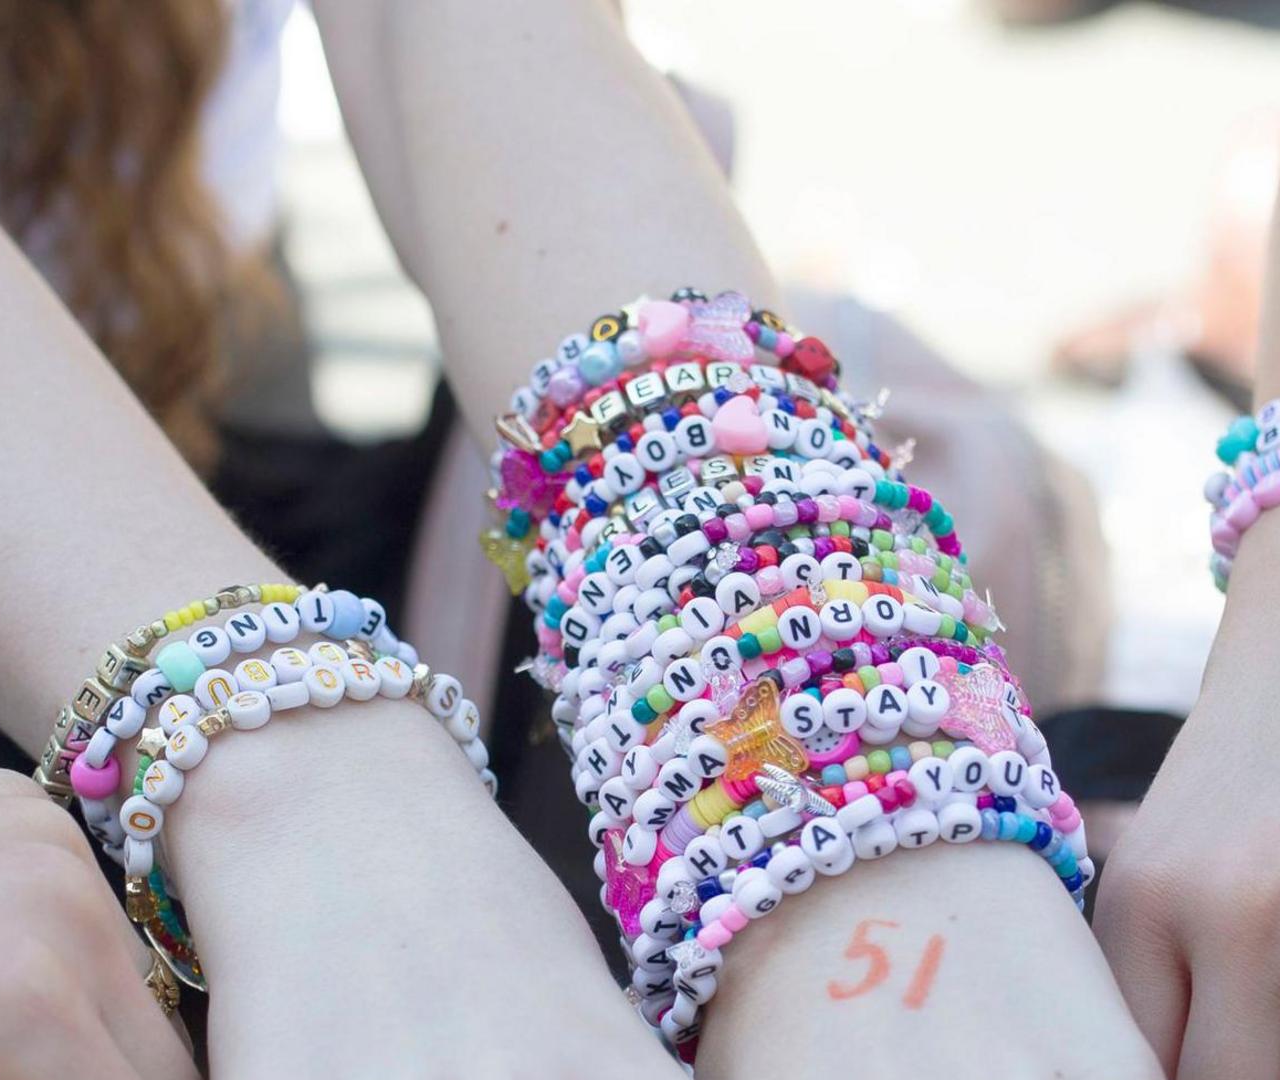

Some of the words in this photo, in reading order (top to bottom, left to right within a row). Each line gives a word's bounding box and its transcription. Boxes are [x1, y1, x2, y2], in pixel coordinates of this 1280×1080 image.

[614, 423, 706, 487] BOY
[792, 685, 937, 734] STAY
[926, 760, 1055, 795] YOUR
[826, 918, 947, 1011] 51
